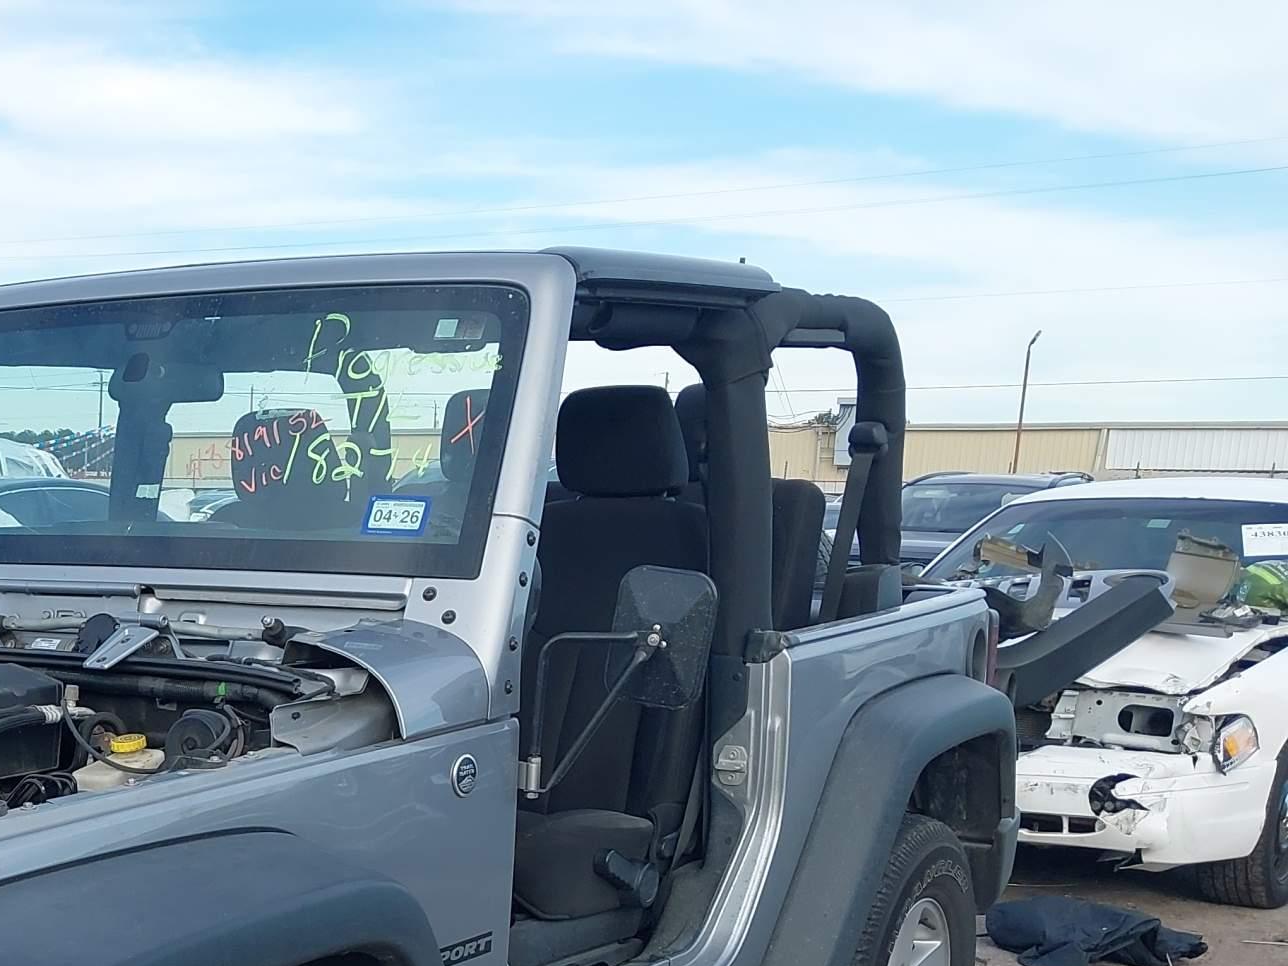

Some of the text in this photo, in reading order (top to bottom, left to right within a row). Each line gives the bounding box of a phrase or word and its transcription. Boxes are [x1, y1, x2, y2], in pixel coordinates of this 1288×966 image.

[373, 509, 420, 525] 04 26
[440, 935, 492, 962] PORT
